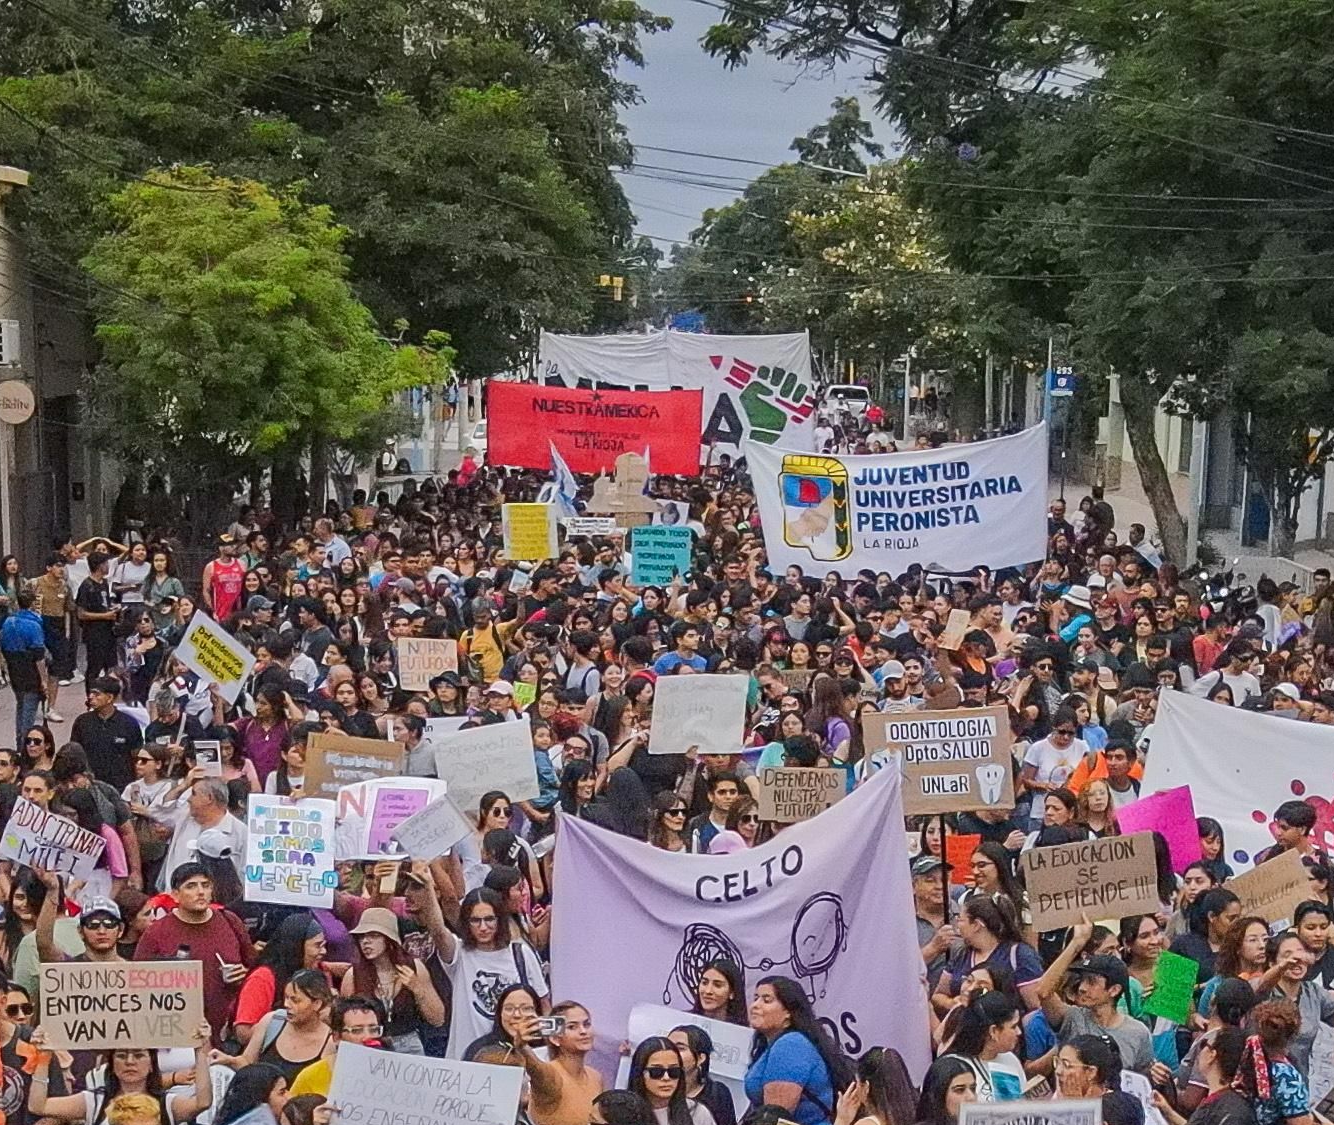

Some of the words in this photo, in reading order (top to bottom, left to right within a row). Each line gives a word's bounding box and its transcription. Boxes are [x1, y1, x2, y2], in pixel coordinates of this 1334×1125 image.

[854, 460, 970, 486] JUVENTUD
[855, 475, 1022, 509] UNIVERSITARIA
[857, 504, 980, 533] PERONISTA
[863, 536, 880, 549] LA
[884, 535, 919, 550] RIOJA
[890, 719, 993, 742] ODONTOLOGIA
[763, 768, 839, 789] DEFENDEMOS
[922, 776, 969, 795] UNLaR
[254, 805, 322, 821] PUEBLO
[250, 818, 323, 838] LEIDO
[17, 837, 80, 876] MILEI
[258, 836, 325, 853] JAMAS
[1028, 852, 1047, 871] LA
[1051, 840, 1135, 868] EDUCACION
[262, 850, 316, 867] SERA
[245, 864, 339, 897] VENCIDO
[695, 844, 804, 903] CELTO
[1077, 867, 1099, 886] SE
[1039, 879, 1128, 913] DEFIENDE
[44, 968, 65, 994] SI
[70, 969, 92, 991] NO
[95, 969, 126, 991] NOS
[46, 994, 142, 1017] ENTONCES
[149, 991, 186, 1012] NOS
[64, 1019, 107, 1043] VAN
[115, 1019, 131, 1040] A
[368, 1055, 401, 1081] VAN
[404, 1062, 462, 1092] CONTRA
[467, 1075, 493, 1096] LA
[433, 1094, 495, 1123] PORQUE
